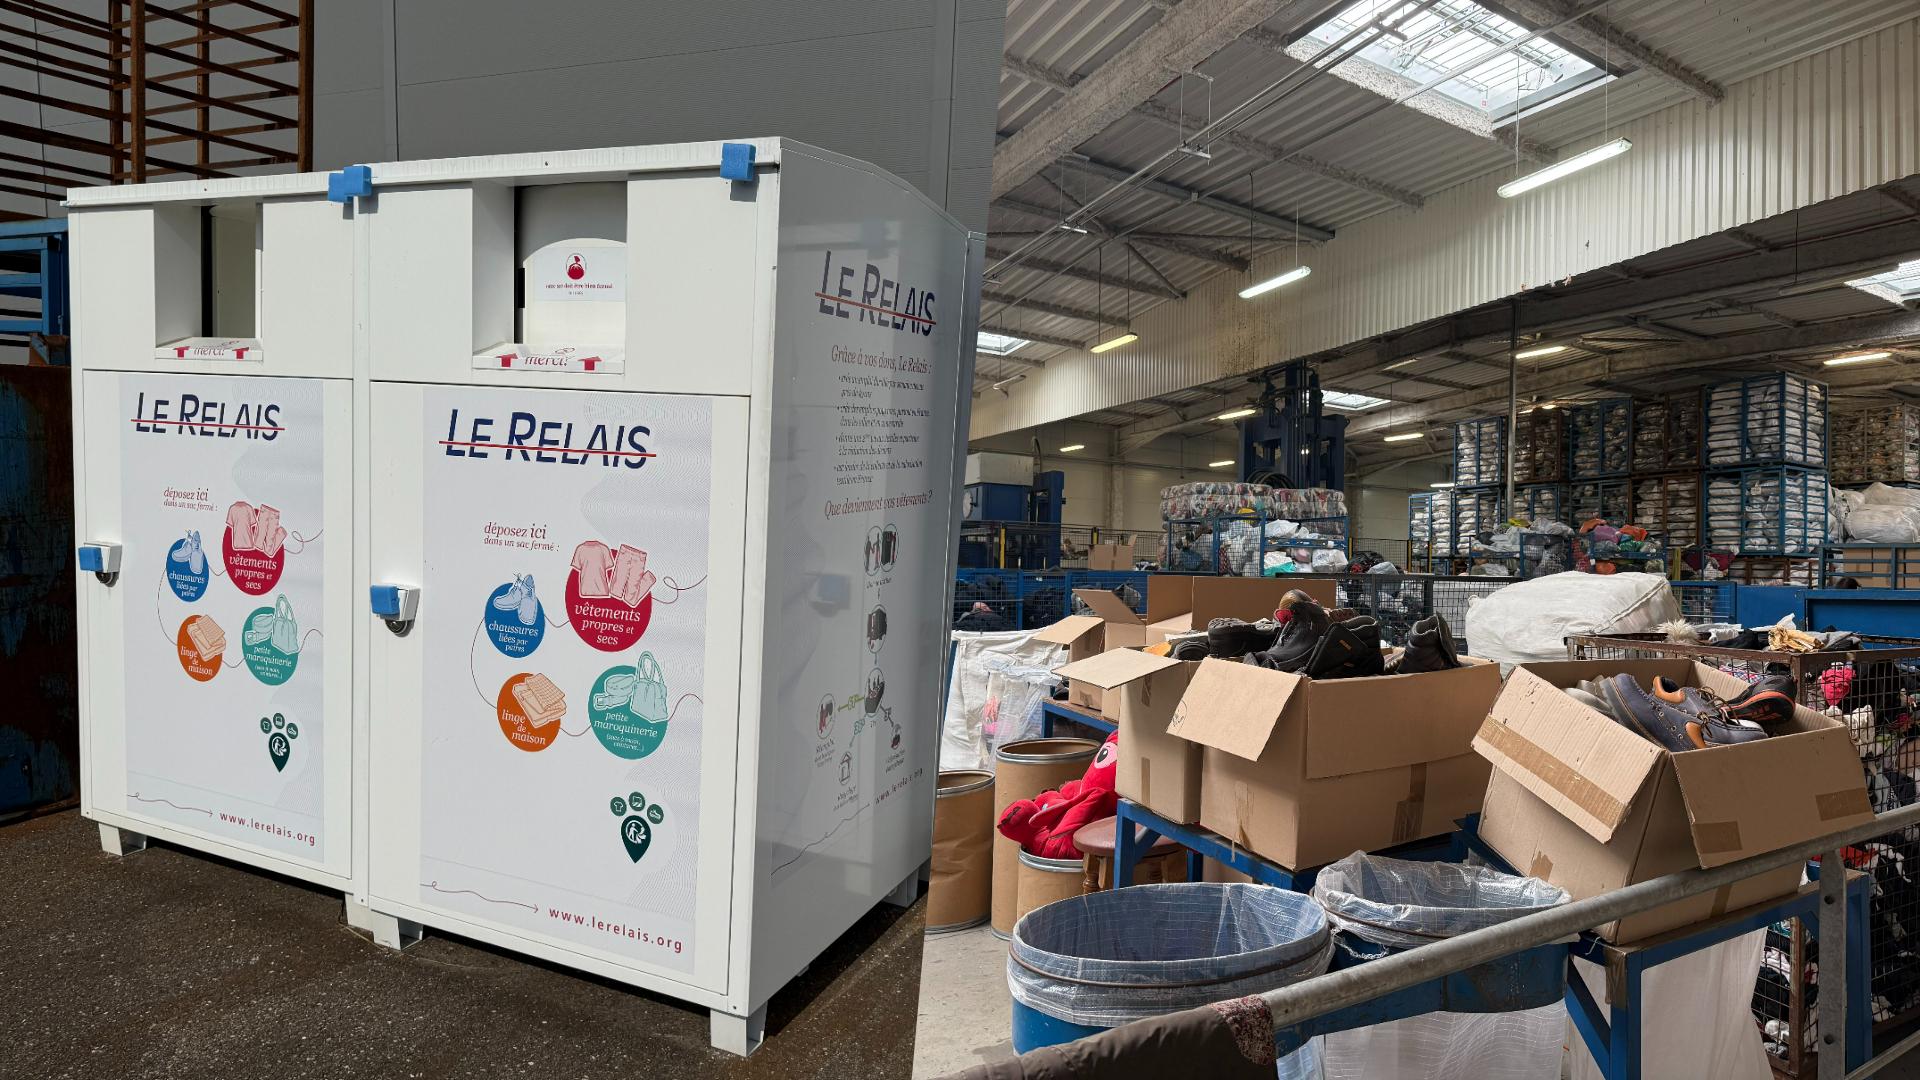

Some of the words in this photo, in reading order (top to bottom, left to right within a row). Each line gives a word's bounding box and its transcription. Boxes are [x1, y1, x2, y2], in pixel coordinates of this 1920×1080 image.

[819, 250, 855, 319] LE
[859, 263, 936, 337] RELAIS
[831, 344, 857, 364] Grâce
[857, 347, 863, 365] à
[864, 354, 878, 367] vos
[898, 355, 907, 371] Le
[136, 392, 170, 434] LE
[177, 393, 281, 441] RELAIS
[445, 408, 494, 459] LE
[504, 411, 651, 470] RELAIS
[163, 486, 195, 501] déposez
[196, 487, 209, 502] ici
[824, 500, 841, 521] Que
[484, 521, 528, 538] déposez
[530, 523, 547, 540] ici
[483, 535, 503, 546] dans
[504, 539, 515, 547] un
[516, 540, 530, 549] sac
[529, 540, 555, 552] fermé
[229, 553, 278, 570] vêtements
[169, 570, 205, 584] chaussures
[235, 568, 266, 580] propres
[245, 581, 262, 590] secs
[575, 601, 641, 622] vêtements
[488, 620, 539, 637] chaussures
[580, 619, 624, 634] propres
[625, 626, 634, 635] et
[498, 632, 516, 644] liées
[596, 634, 619, 645] secs
[180, 645, 198, 660] linge
[246, 653, 292, 667] maroquinerie
[191, 657, 199, 666] de
[188, 664, 213, 676] maison
[502, 709, 526, 725] linge
[605, 712, 629, 722] petite
[517, 723, 527, 733] de
[593, 720, 658, 738] maroquinerie
[511, 732, 546, 745] maison
[219, 811, 316, 847] www.lerelais.org
[549, 908, 683, 954] www.lerelais.org
